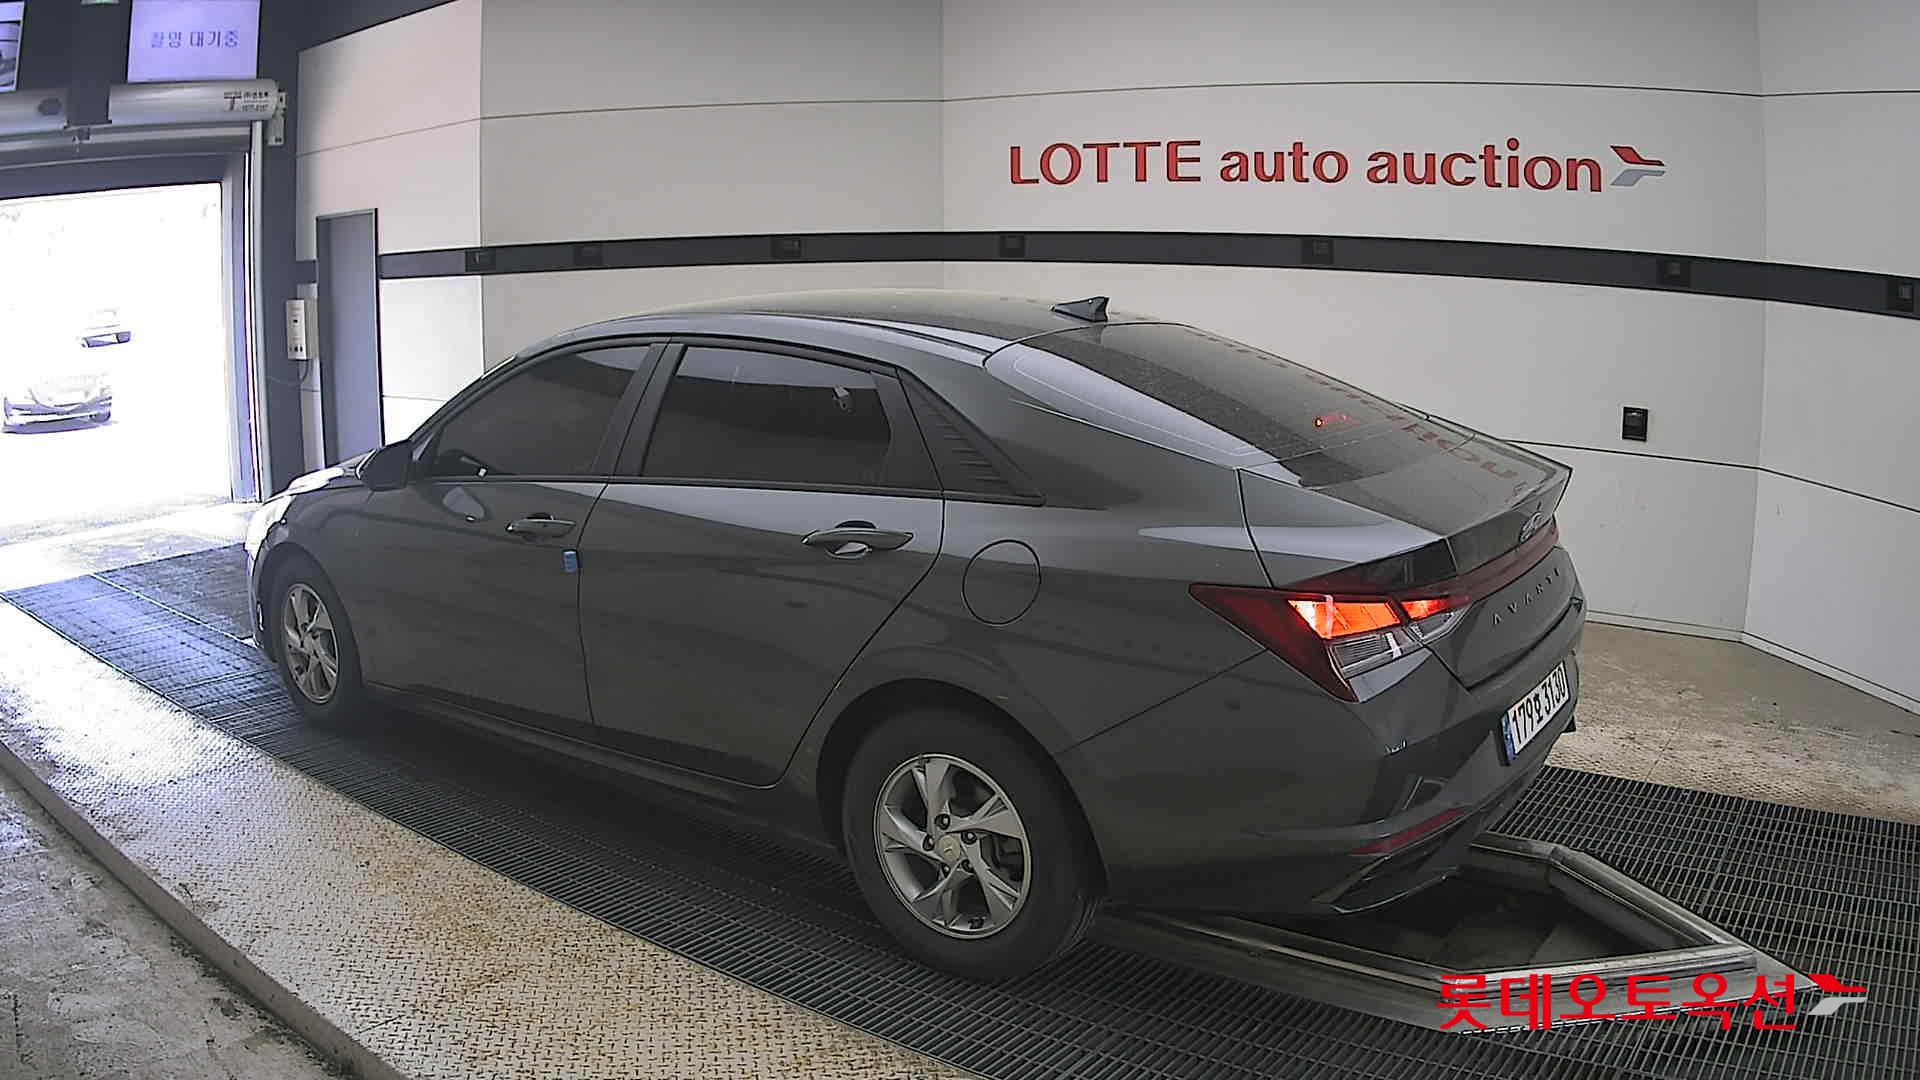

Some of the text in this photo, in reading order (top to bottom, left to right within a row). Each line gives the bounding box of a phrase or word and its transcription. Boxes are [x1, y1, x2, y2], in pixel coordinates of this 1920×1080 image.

[190, 30, 239, 48] 대기중
[1010, 137, 1602, 193] LOTTE auto auction
[1541, 666, 1567, 716] 3130
